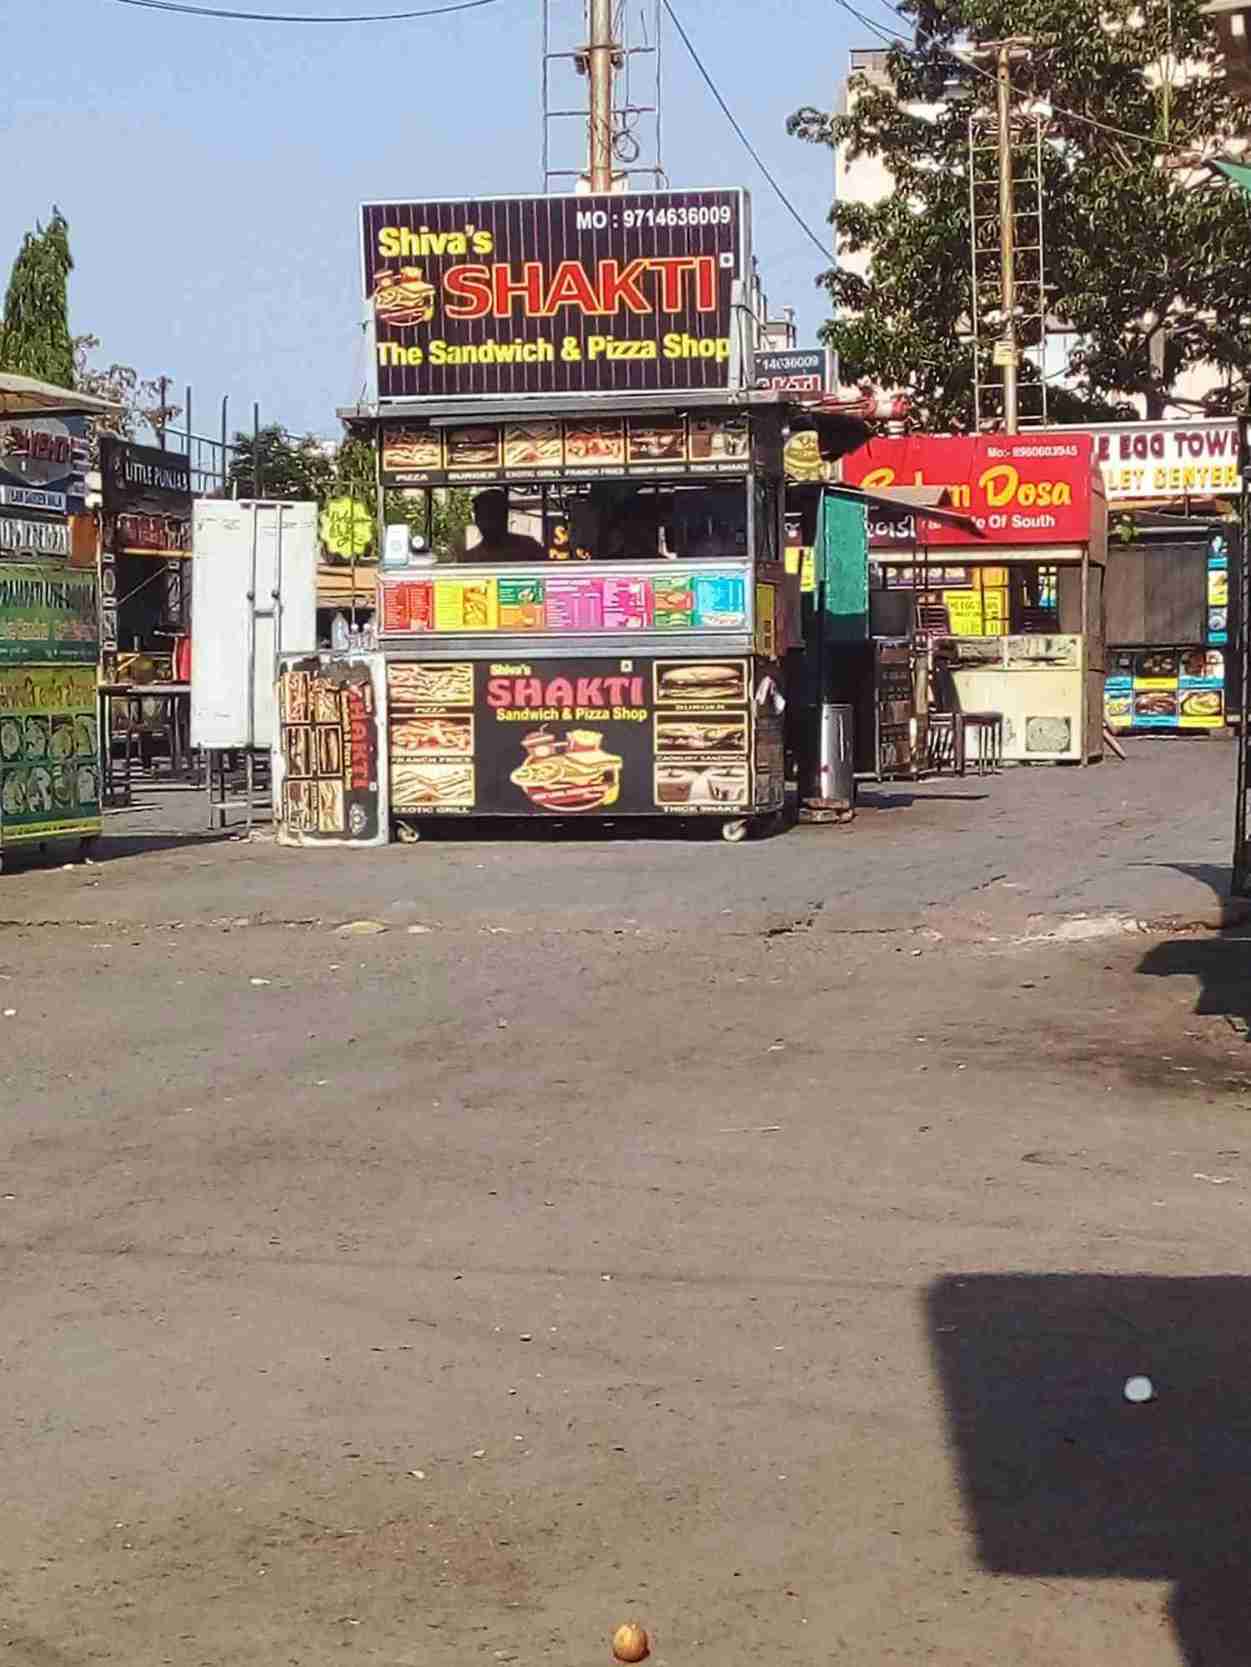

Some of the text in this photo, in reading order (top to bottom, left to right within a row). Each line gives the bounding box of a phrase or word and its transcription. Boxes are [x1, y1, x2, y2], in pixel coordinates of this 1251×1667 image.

[576, 211, 607, 229] MO
[623, 205, 731, 228] 9714636009
[378, 224, 493, 258] Shiva's
[443, 256, 715, 319] SHAKTI
[377, 333, 730, 366] The Sandwich & Pizza Shop
[979, 464, 1072, 507] Dosa
[986, 514, 1007, 528] Of
[1011, 513, 1055, 529] South
[487, 676, 644, 707] SHAKTI
[496, 706, 648, 722] Sandwich & Pizza Shop
